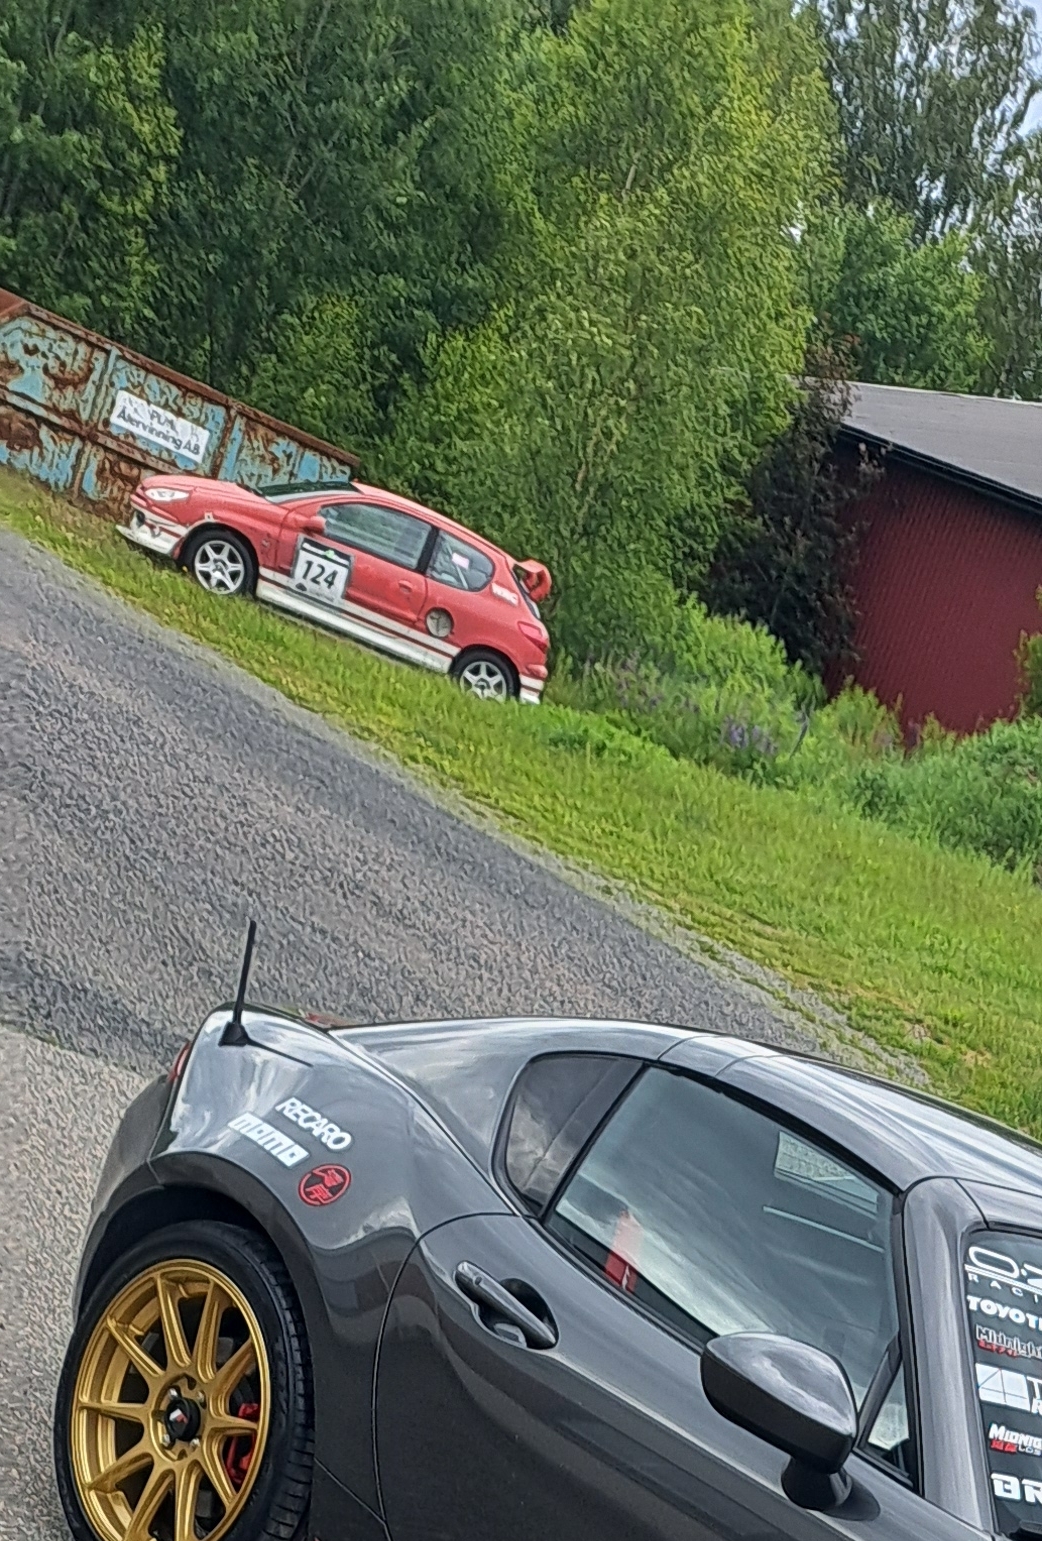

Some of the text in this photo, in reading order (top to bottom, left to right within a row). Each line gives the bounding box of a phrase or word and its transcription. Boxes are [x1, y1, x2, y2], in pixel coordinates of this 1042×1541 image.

[183, 440, 200, 455] AB
[302, 560, 338, 589] 124
[274, 1096, 352, 1150] RECARO
